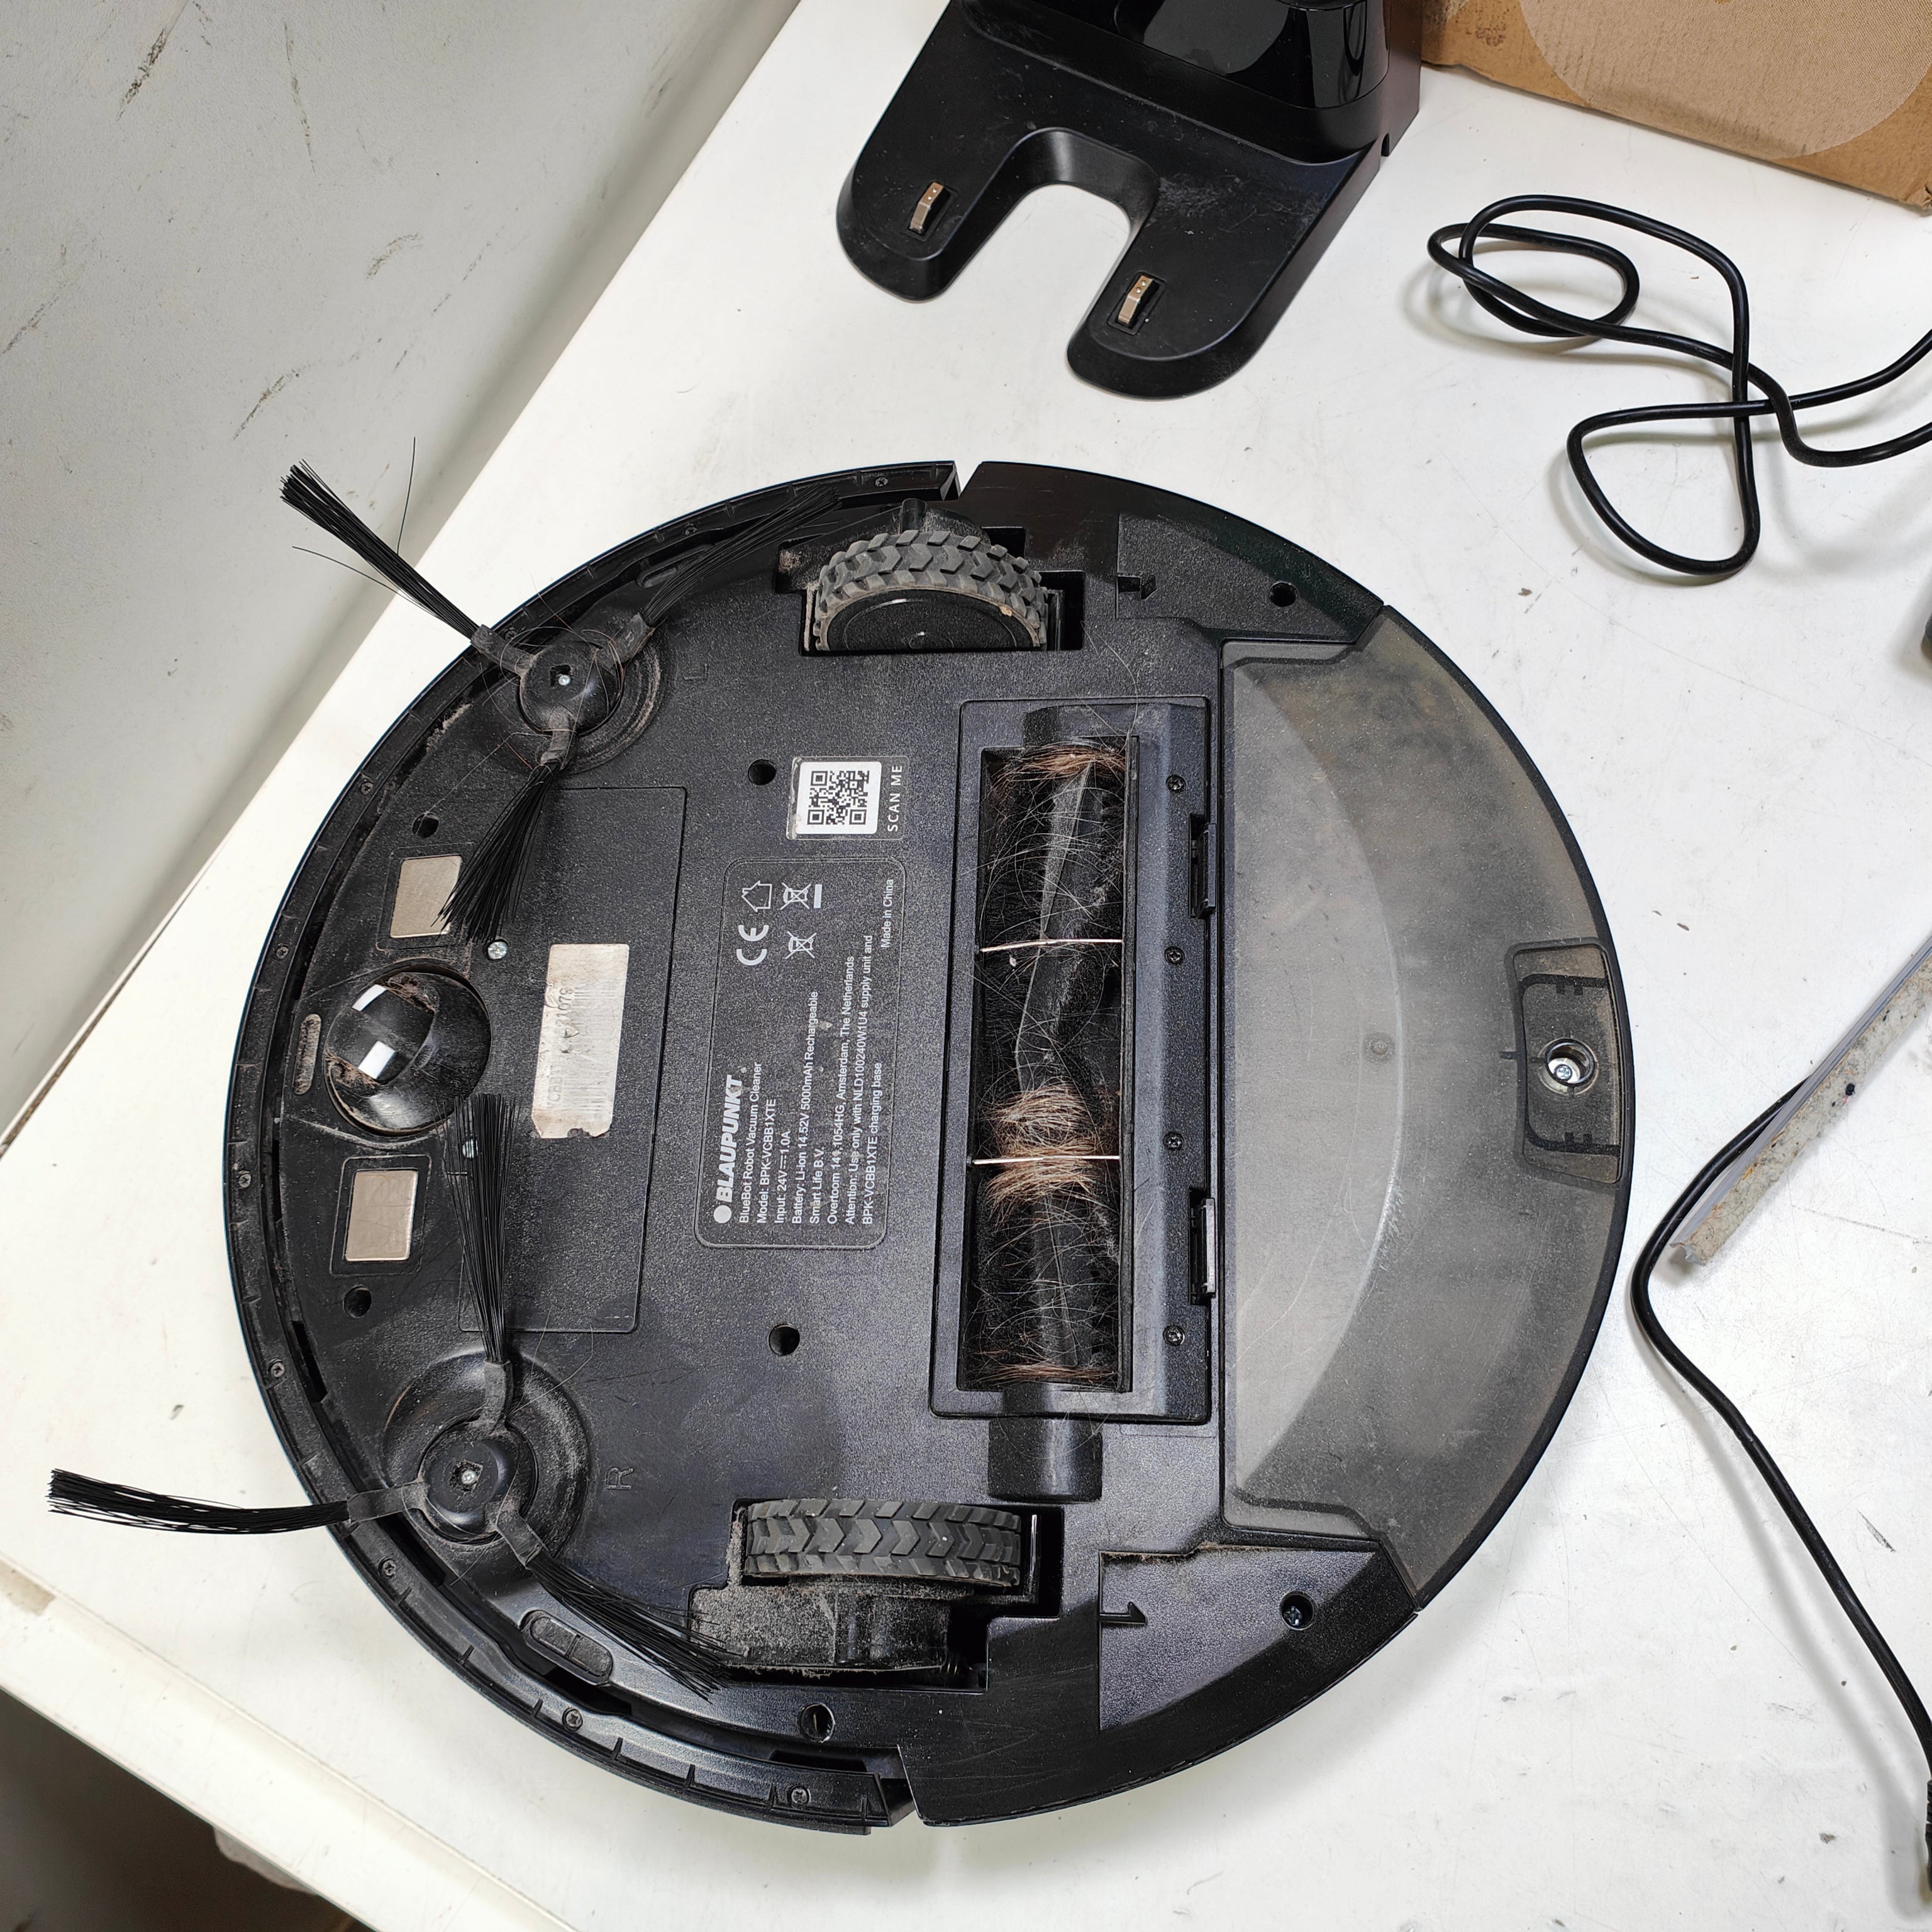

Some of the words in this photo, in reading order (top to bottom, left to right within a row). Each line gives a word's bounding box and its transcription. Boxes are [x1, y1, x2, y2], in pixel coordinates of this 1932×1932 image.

[890, 765, 903, 786] ME
[887, 793, 901, 832] SCAN
[882, 879, 894, 906] China
[882, 910, 892, 919] in
[862, 935, 873, 953] and
[880, 921, 892, 948] Made
[862, 956, 872, 974] unit
[841, 956, 855, 1014] Netherlands
[859, 976, 872, 1008] supply
[804, 991, 818, 1060] Rechargeable
[840, 1018, 851, 1036] The
[836, 1040, 851, 1101] Amsterdam,
[853, 1011, 868, 1101] NLD100240W1U4
[750, 1062, 762, 1102] Cleaner
[801, 1062, 813, 1110] 5000mAh
[871, 1062, 882, 1087] base
[745, 1104, 758, 1146] Vacuum
[851, 1104, 863, 1124] with
[868, 1090, 882, 1134] charging
[716, 1074, 742, 1203] BLAUPUNKT
[760, 1099, 776, 1185] BPK-VCBB1XTE
[797, 1113, 810, 1148] 14.52V
[851, 1127, 863, 1148] only
[743, 1148, 755, 1179] Robot
[795, 1152, 807, 1180] Li-ion
[813, 1146, 824, 1168] B.V.
[848, 1151, 860, 1172] Use
[812, 1170, 823, 1189] Life
[862, 1136, 878, 1224] BPK-VCBB1XTE
[739, 1182, 753, 1224] BlueBot
[757, 1188, 769, 1224] Model:
[774, 1194, 787, 1224] Input:
[792, 1184, 805, 1224] Battery:
[809, 1192, 821, 1224] Smart
[827, 1173, 841, 1224] Overtoom
[845, 1175, 858, 1225] Attention:
[605, 1466, 635, 1491] R
